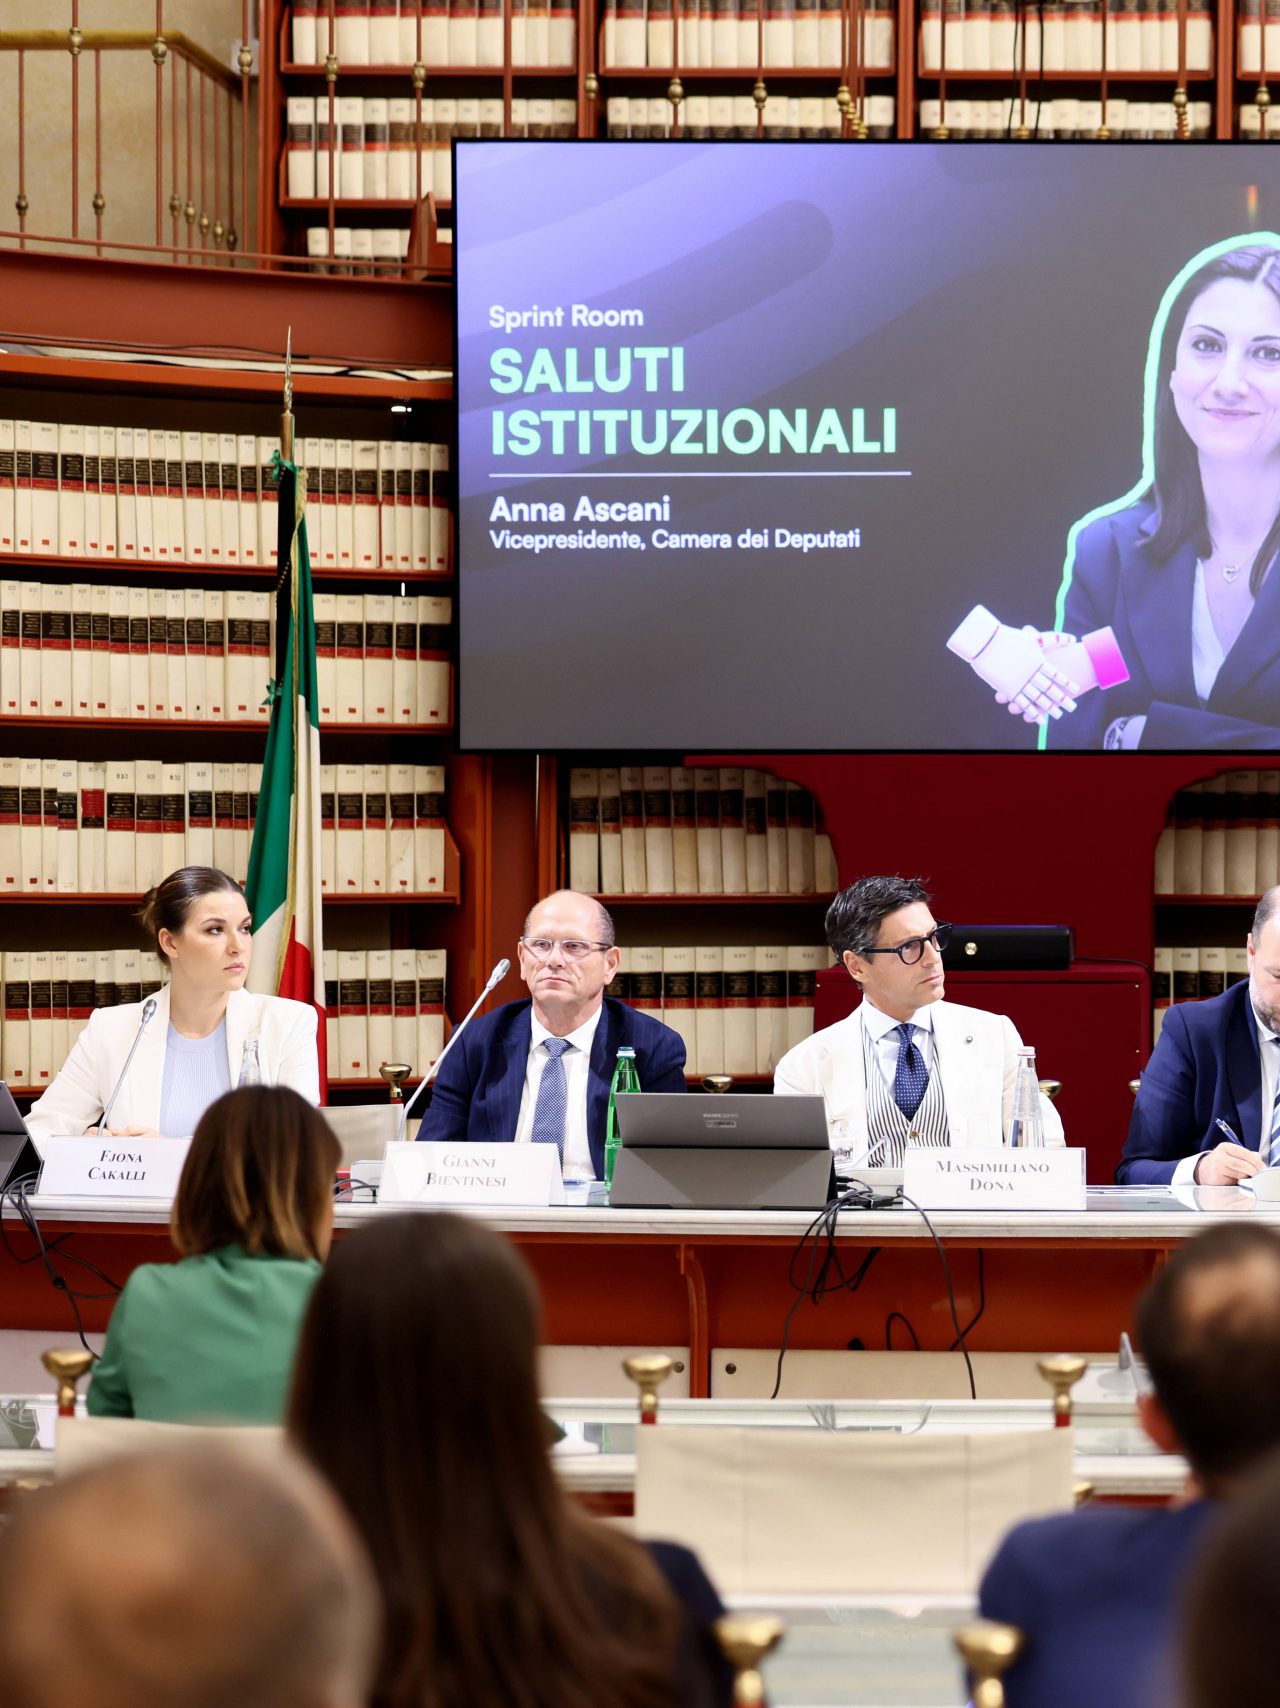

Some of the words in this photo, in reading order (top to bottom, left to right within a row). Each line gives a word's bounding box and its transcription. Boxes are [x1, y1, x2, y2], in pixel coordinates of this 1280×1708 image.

[489, 305, 564, 332] Sprint
[571, 304, 644, 327] Room
[489, 346, 684, 394] SALUTI
[492, 407, 896, 456] ISTITUZIONALI
[490, 496, 566, 522] Anna
[573, 495, 671, 521] Ascani
[490, 529, 646, 552] Vicepresidente,
[651, 529, 732, 549] Camera
[737, 528, 770, 548] dei
[775, 528, 861, 551] Deputati
